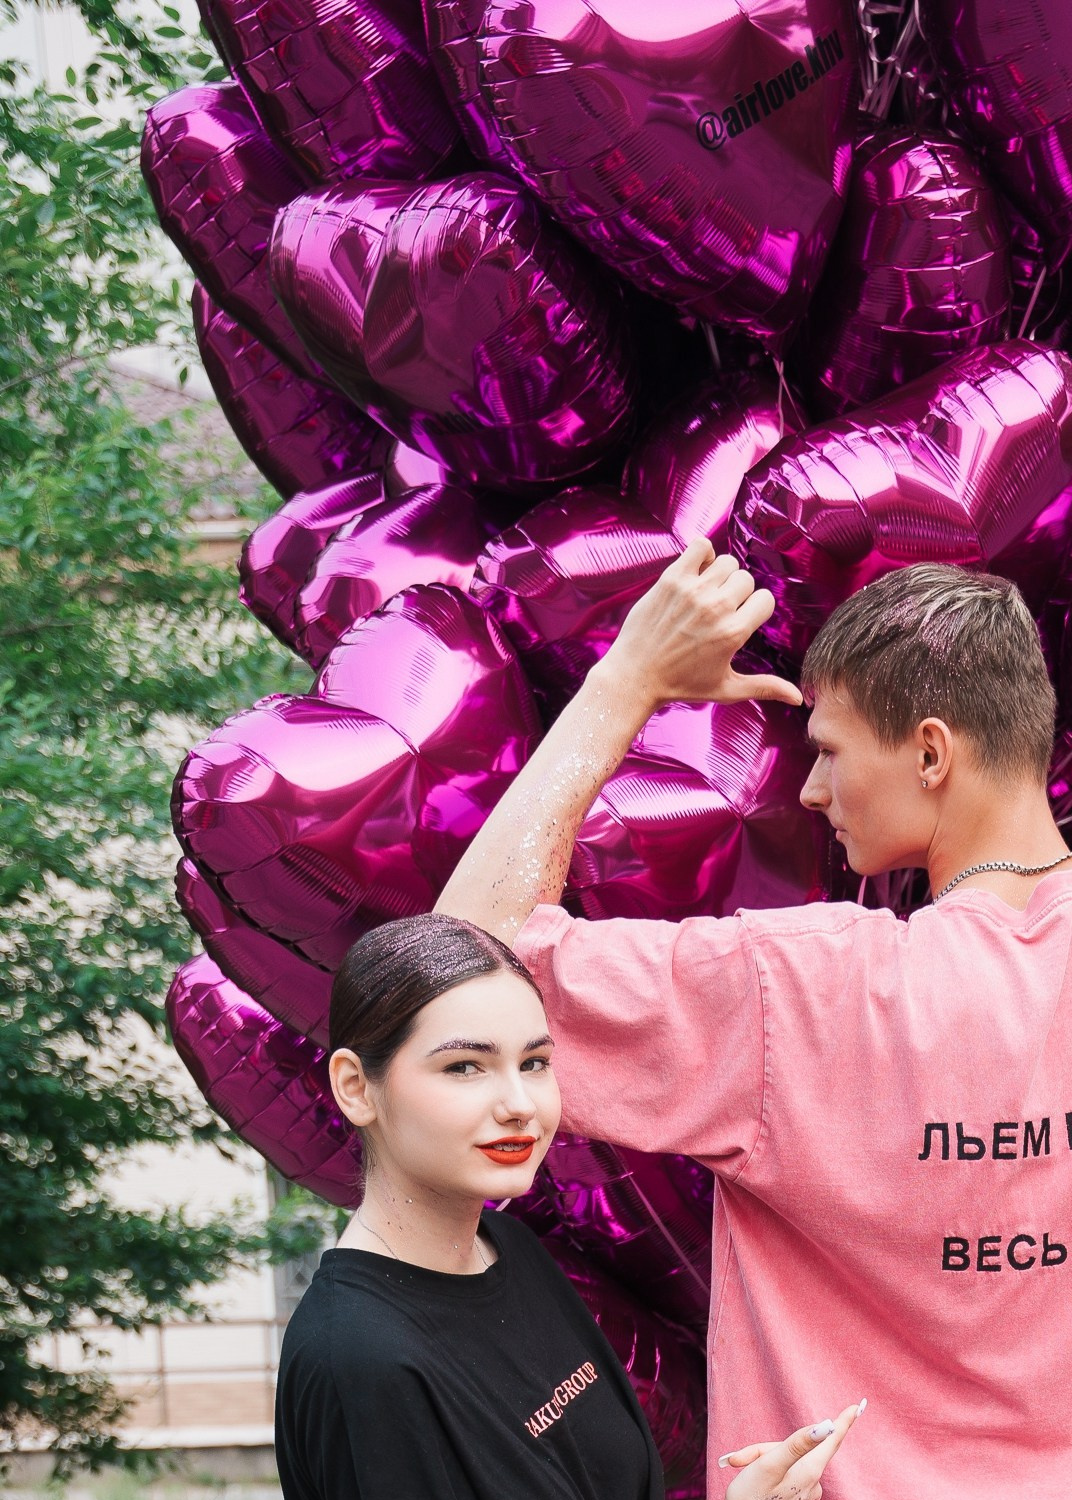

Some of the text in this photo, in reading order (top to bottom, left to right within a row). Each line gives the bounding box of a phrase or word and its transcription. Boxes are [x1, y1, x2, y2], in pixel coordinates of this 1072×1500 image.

[695, 29, 844, 151] @airlove.khv
[917, 1116, 1051, 1161] ЛЬЕМ
[941, 1232, 1068, 1272] ВЕСЬ
